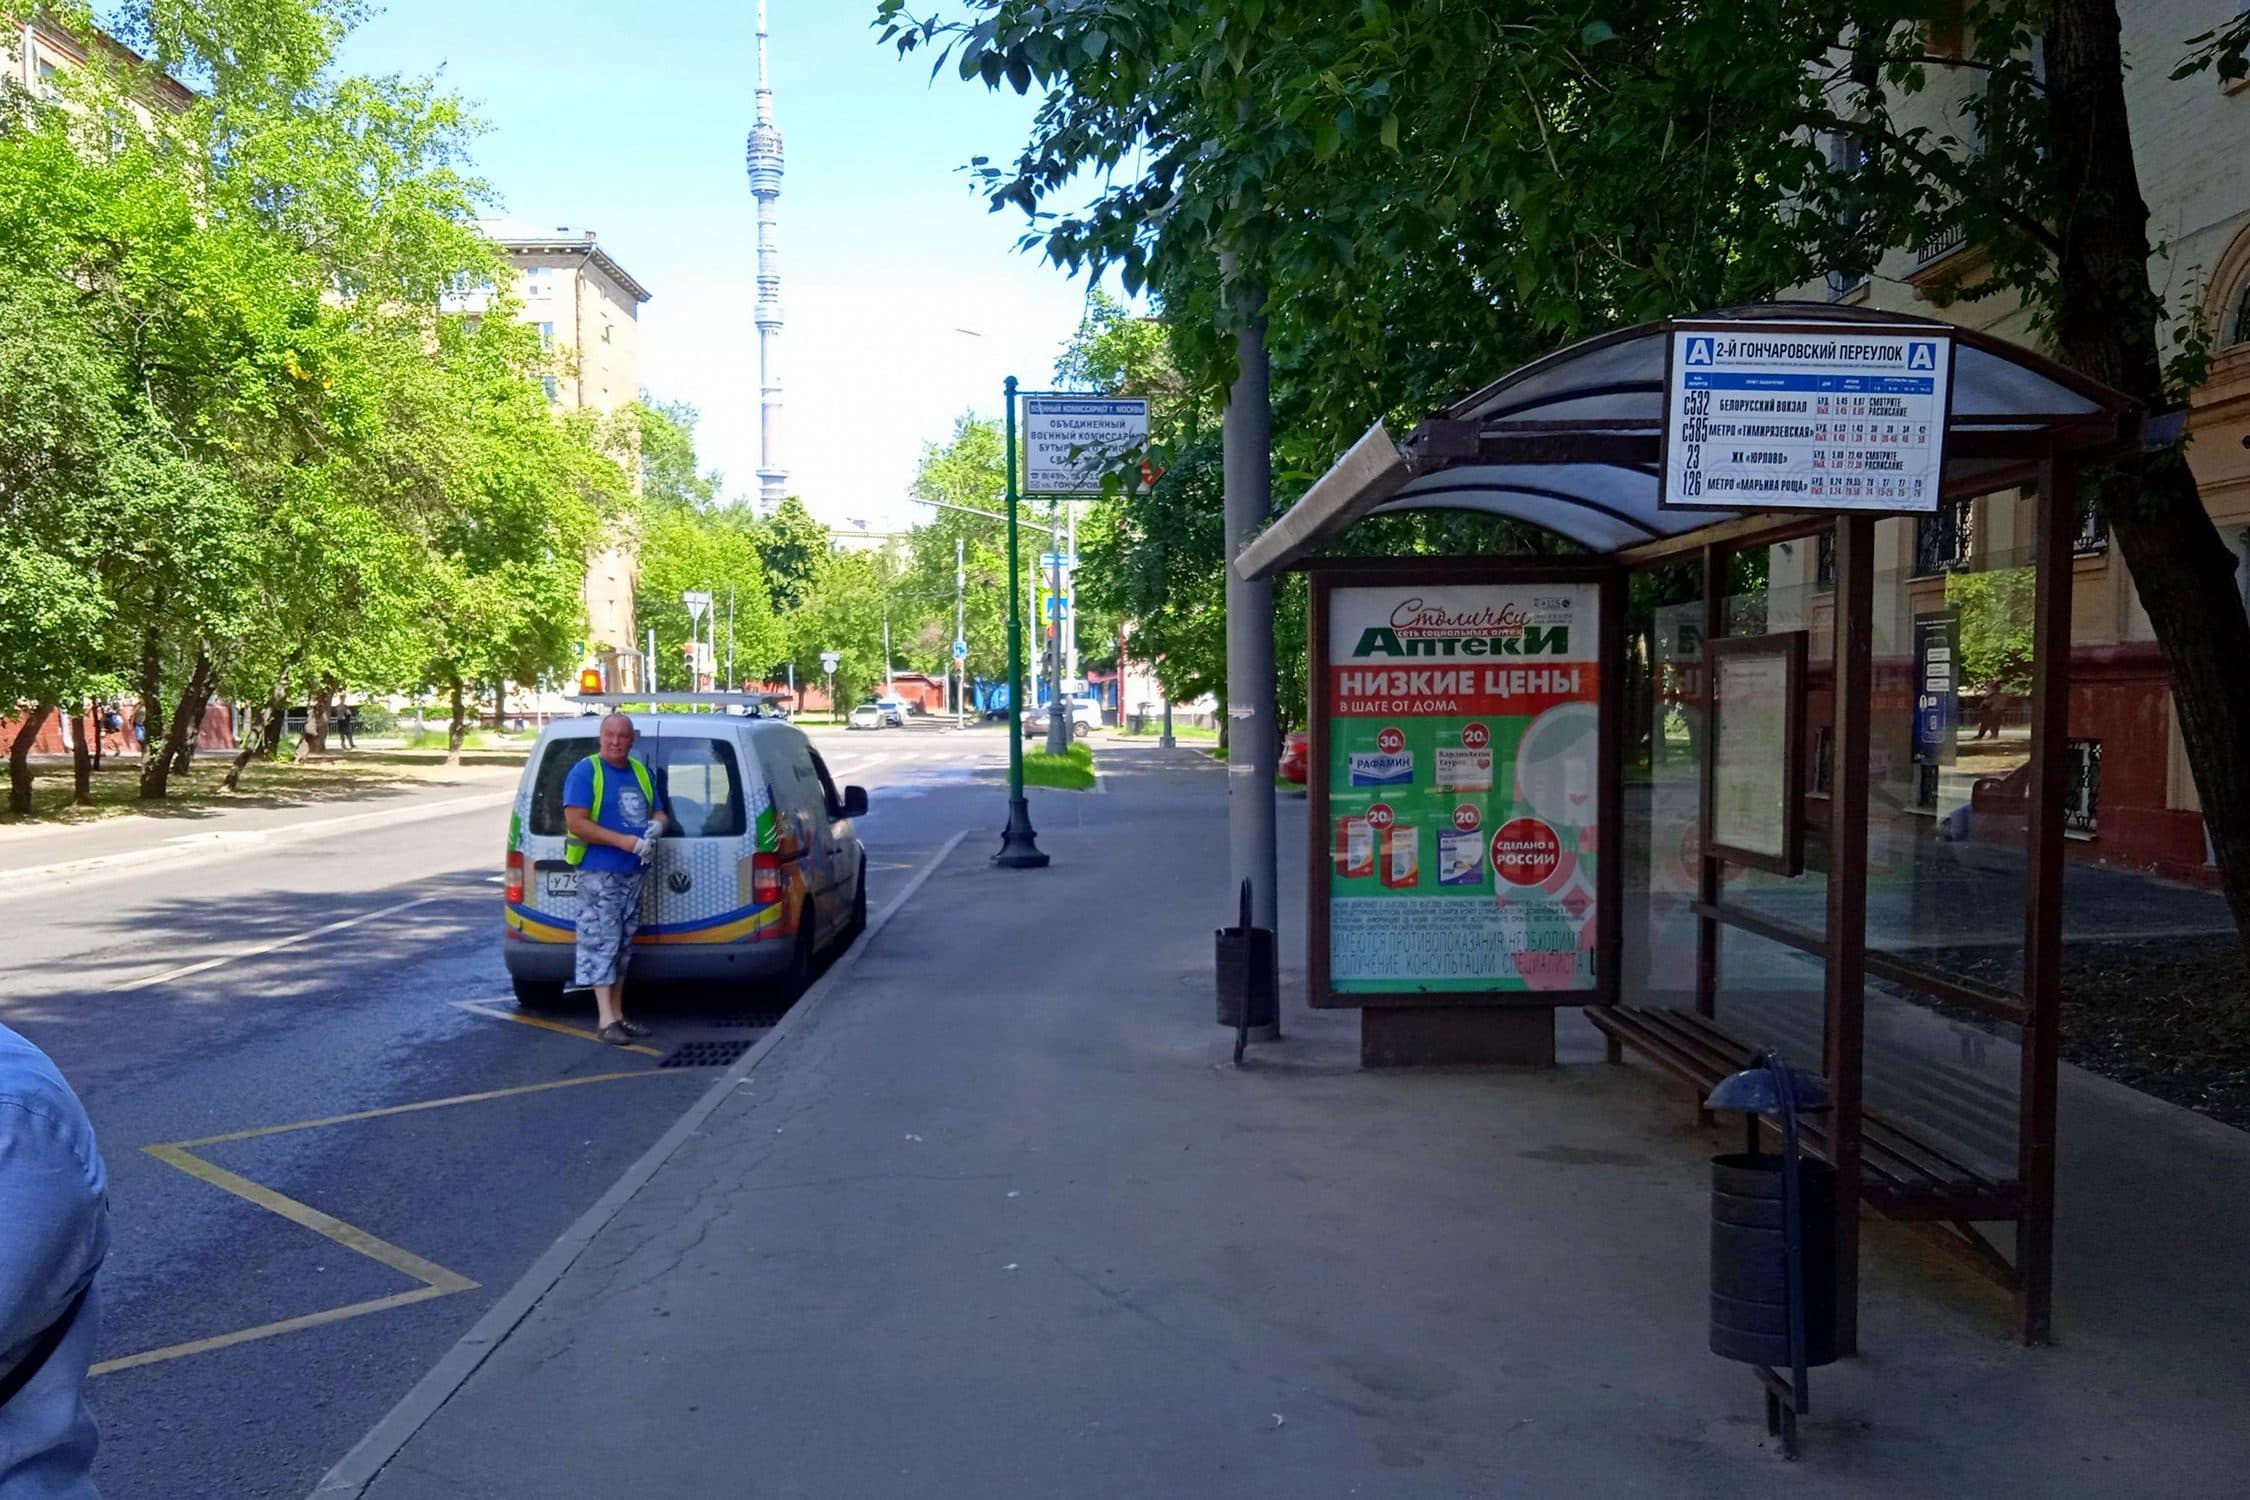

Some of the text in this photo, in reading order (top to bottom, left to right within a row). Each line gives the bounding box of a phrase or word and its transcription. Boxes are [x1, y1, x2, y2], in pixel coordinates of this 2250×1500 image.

[1716, 339, 1903, 361] 2-Й ГОНЧАРОВСКИЙ ПЕРЕУЛОК
[1719, 397, 1774, 413] БЕЛОРУССКИЙ
[1776, 400, 1807, 413] ВОКЗАЛ
[1031, 431, 1076, 440] ВОЕННЫЙ
[1708, 424, 1736, 437] МЕТРО
[1686, 444, 1700, 469] 23
[1731, 452, 1744, 463] ЖК
[1682, 470, 1701, 496] 126
[1707, 478, 1734, 491] МЕТРО
[1390, 598, 1531, 627] Столички
[1397, 628, 1522, 638] сеть социальных аптек
[1339, 669, 1581, 698] НИЗКИЕ ЦЕНЫ
[1340, 700, 1457, 713] В ШАГЕ ОТ ДОМА
[1357, 757, 1410, 769] РАФАМИН
[1497, 841, 1546, 851] СДЕЛАНО
[1497, 854, 1555, 866] РОССИИ
[1405, 953, 1496, 976] КОНСУЛЬТАЦИИ
